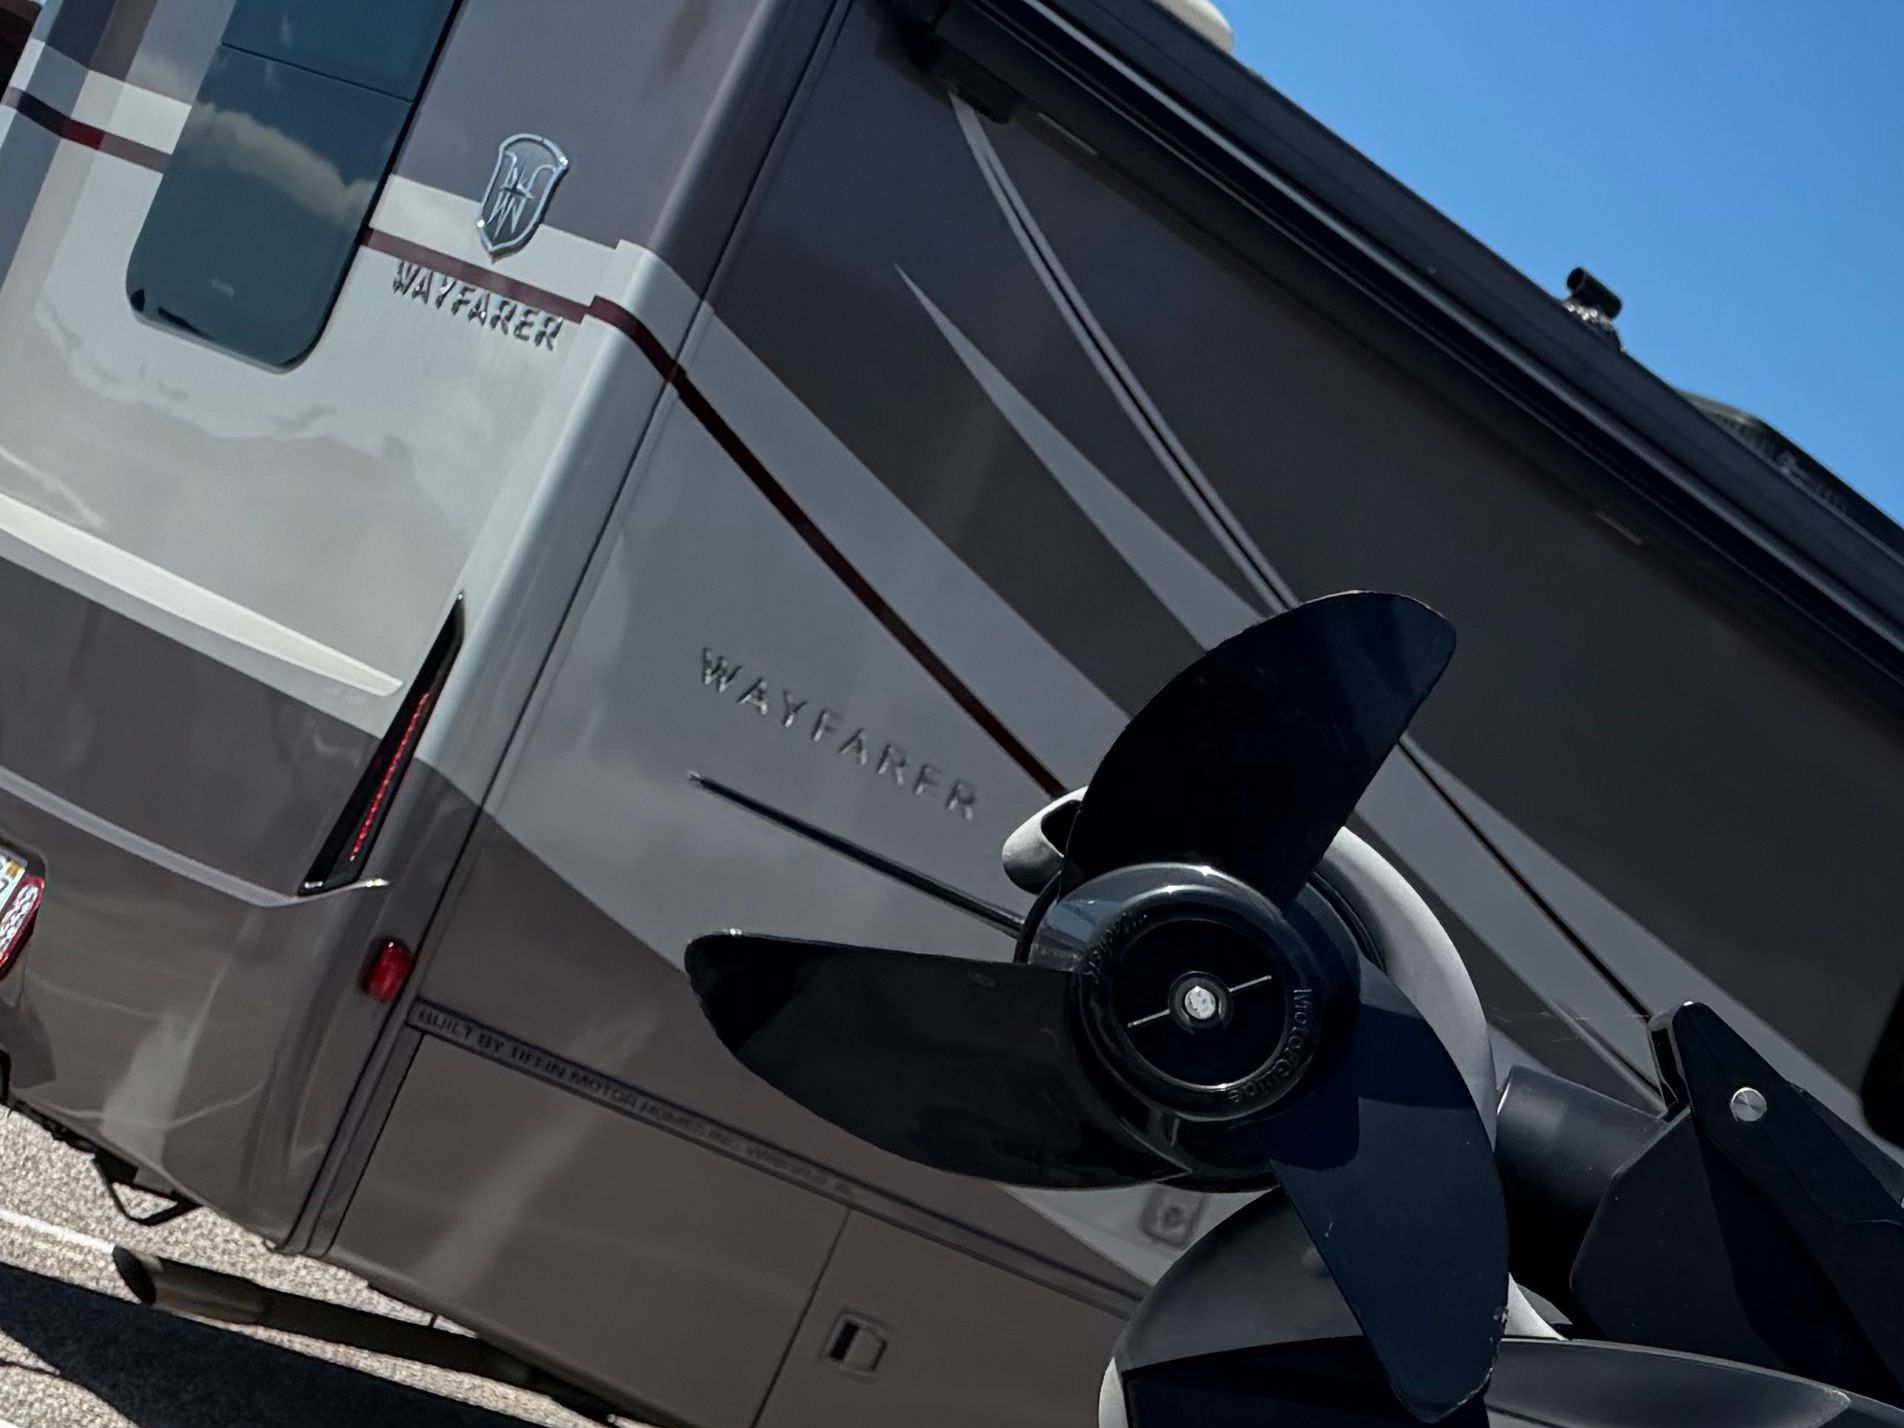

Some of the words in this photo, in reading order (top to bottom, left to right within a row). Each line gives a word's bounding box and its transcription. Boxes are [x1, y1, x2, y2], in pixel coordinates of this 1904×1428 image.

[392, 259, 564, 351] WAYFARER
[702, 647, 977, 820] WAYFARER
[418, 1008, 473, 1040] BUILT
[478, 1033, 505, 1052] BY
